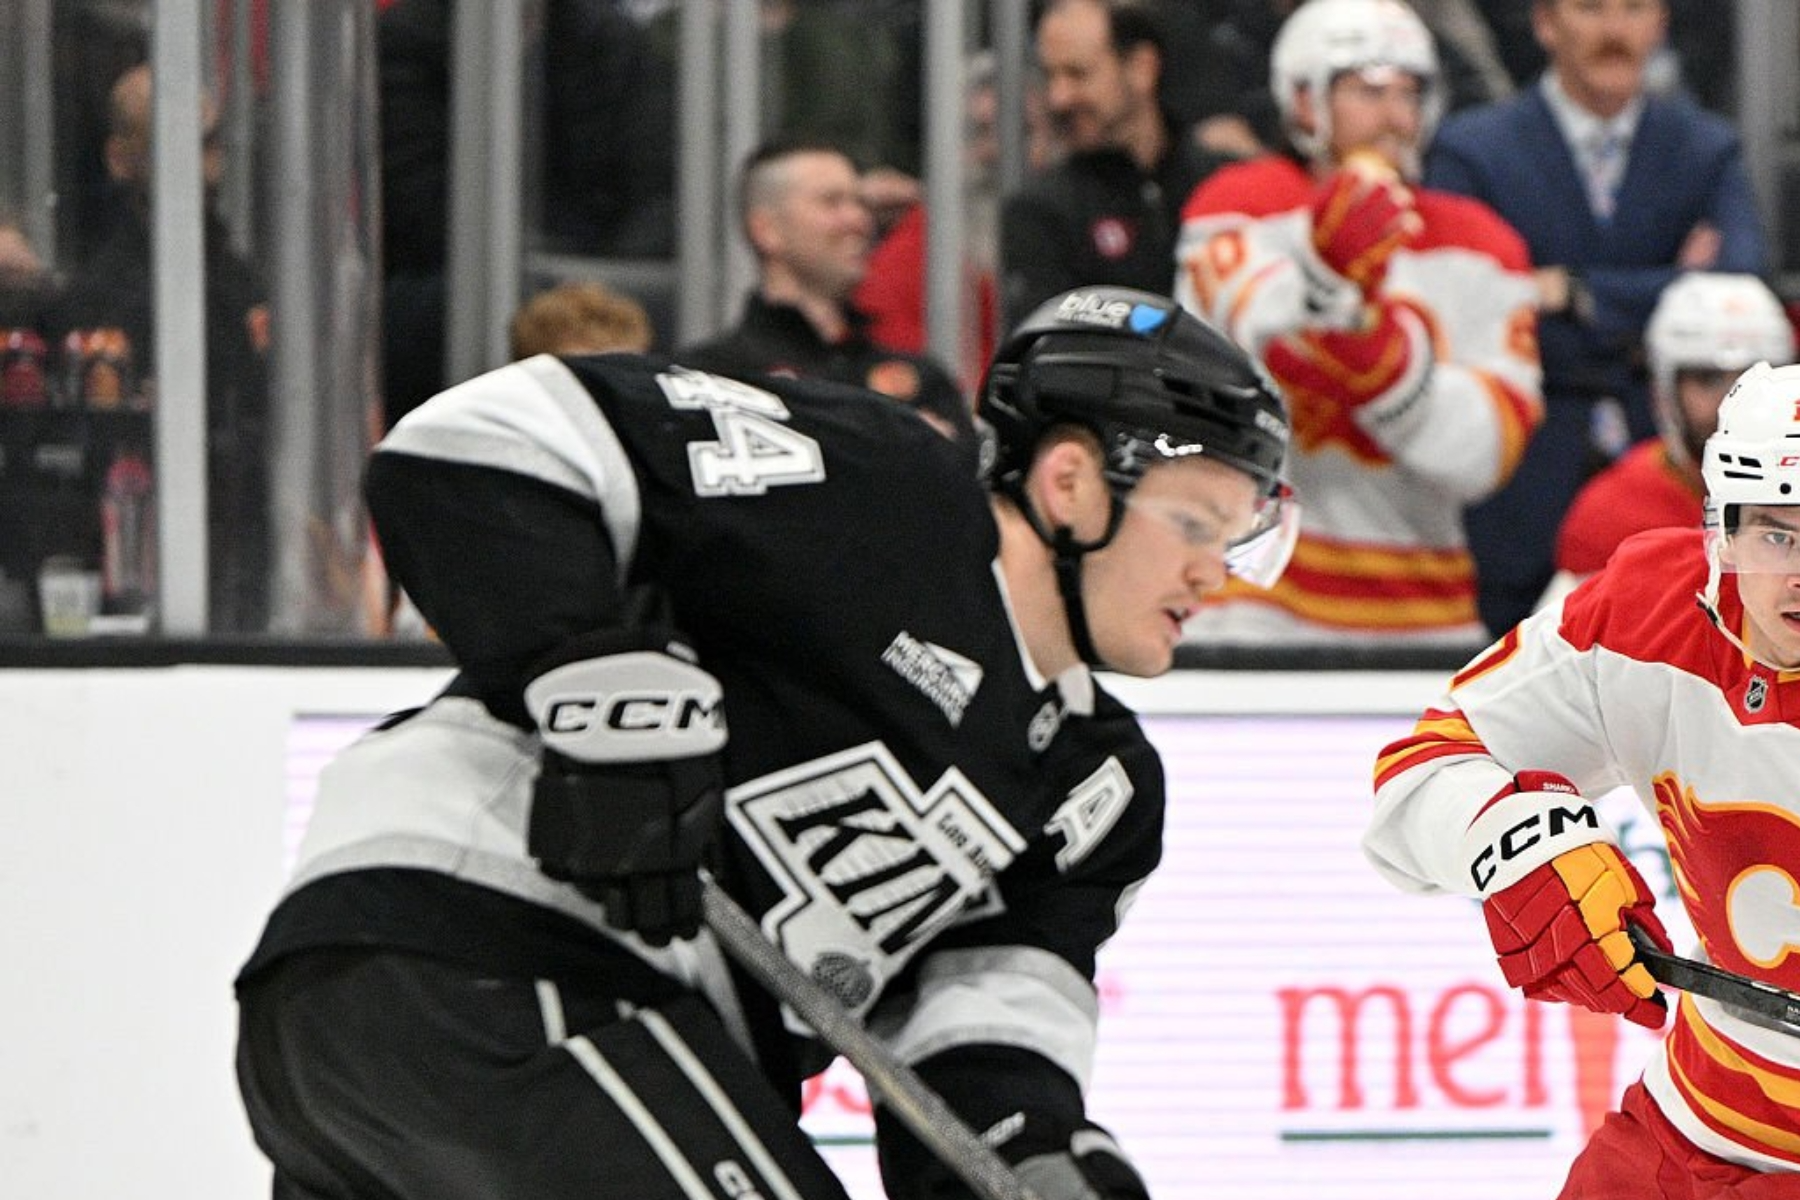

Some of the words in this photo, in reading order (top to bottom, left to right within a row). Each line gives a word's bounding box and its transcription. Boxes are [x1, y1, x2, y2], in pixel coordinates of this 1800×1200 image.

[1055, 291, 1132, 320] blue
[654, 364, 827, 497] 44
[547, 697, 727, 734] CCM
[1042, 755, 1135, 874] A
[1470, 804, 1599, 892] CCM
